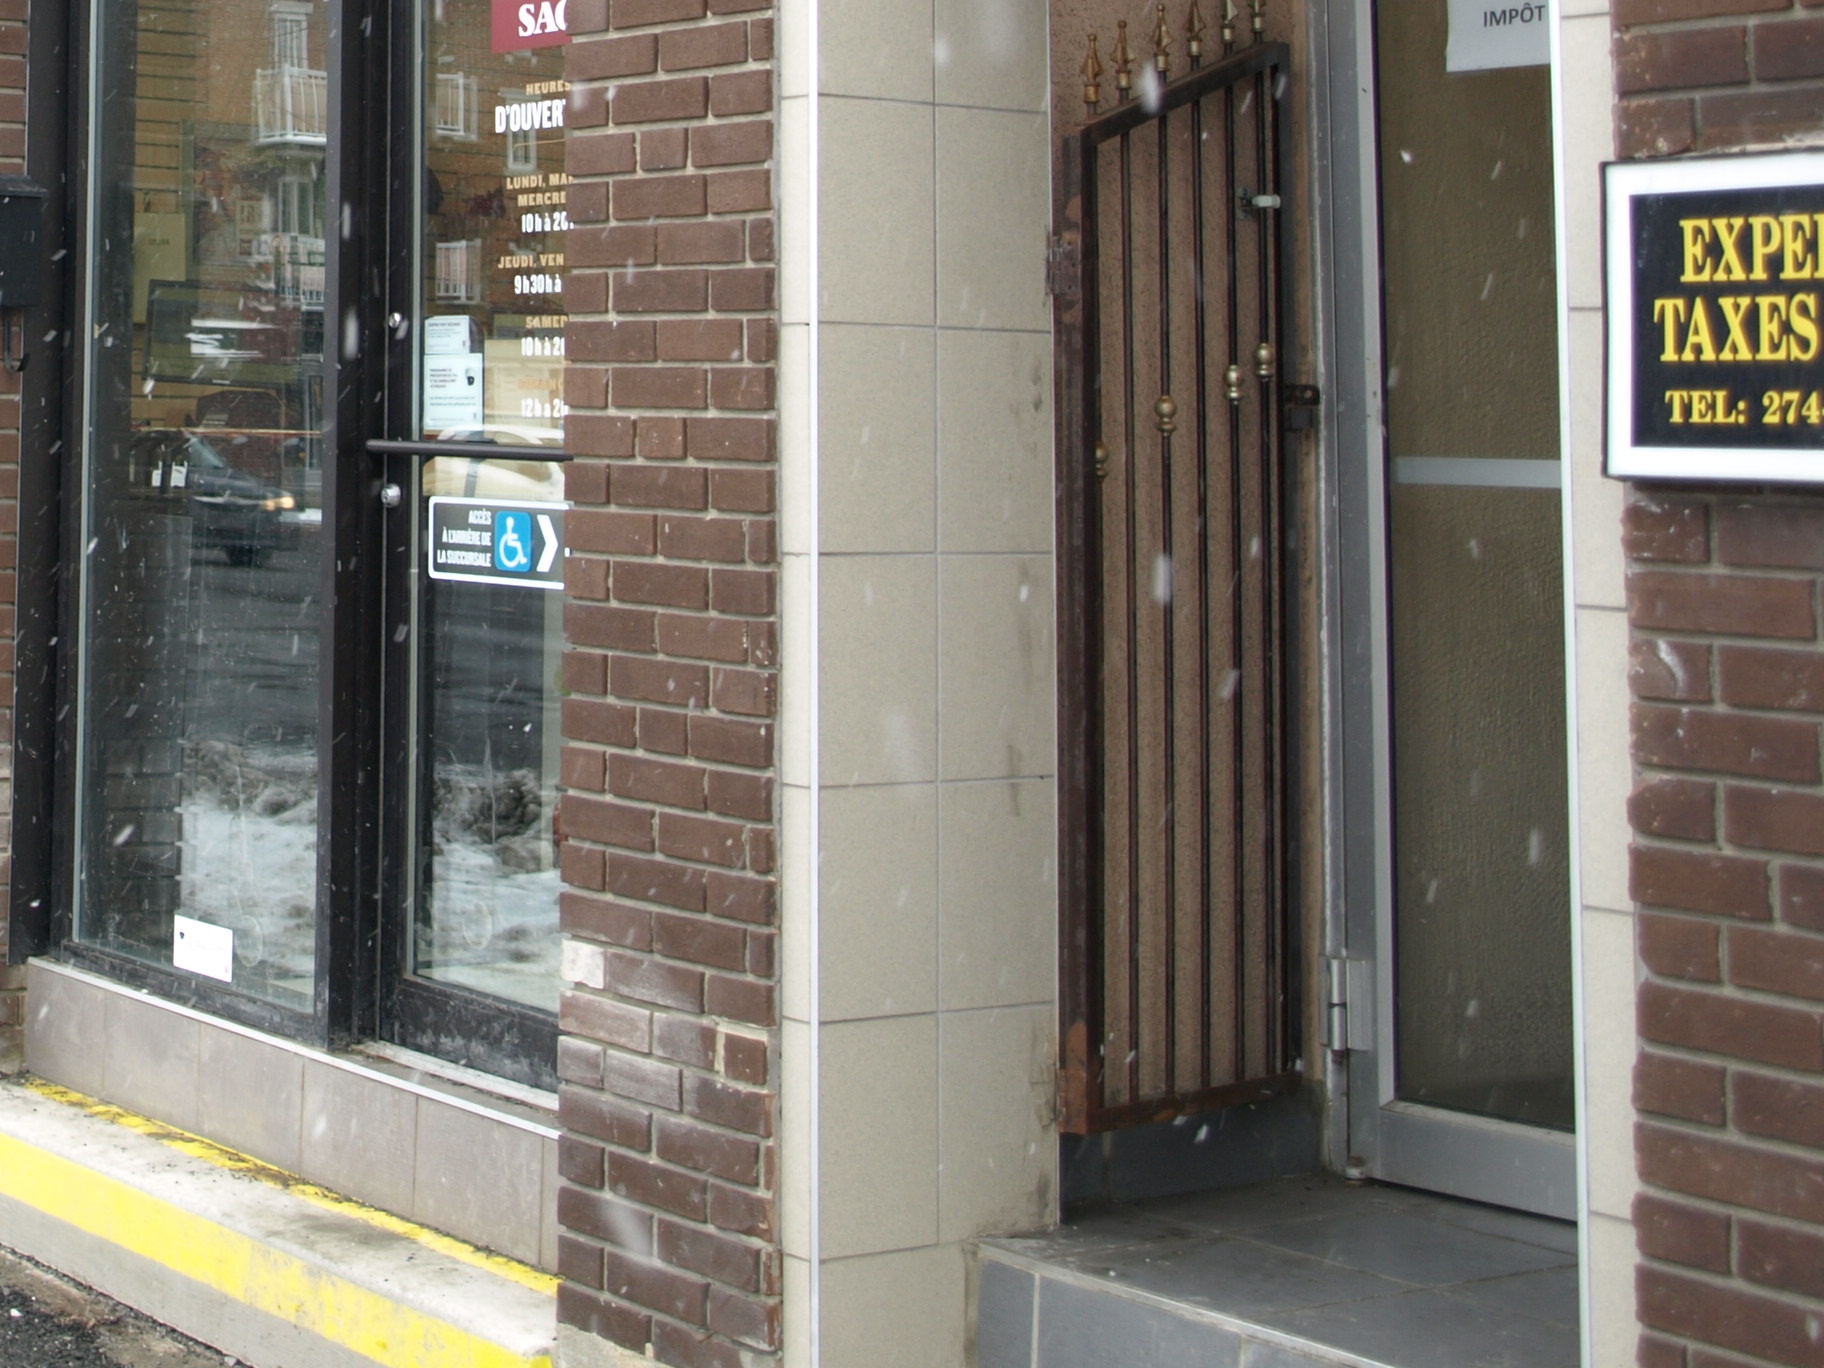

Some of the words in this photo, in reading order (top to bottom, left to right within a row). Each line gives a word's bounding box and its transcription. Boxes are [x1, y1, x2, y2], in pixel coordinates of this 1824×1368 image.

[1483, 2, 1546, 28] IMPÔT
[526, 79, 572, 96] HEURES
[495, 98, 566, 133] D'OUVER
[506, 174, 546, 190] LUNDI,
[497, 255, 537, 269] JEUDI,
[1654, 293, 1818, 362] TAXES
[1665, 390, 1747, 425] TEL:
[1762, 390, 1824, 425] 274
